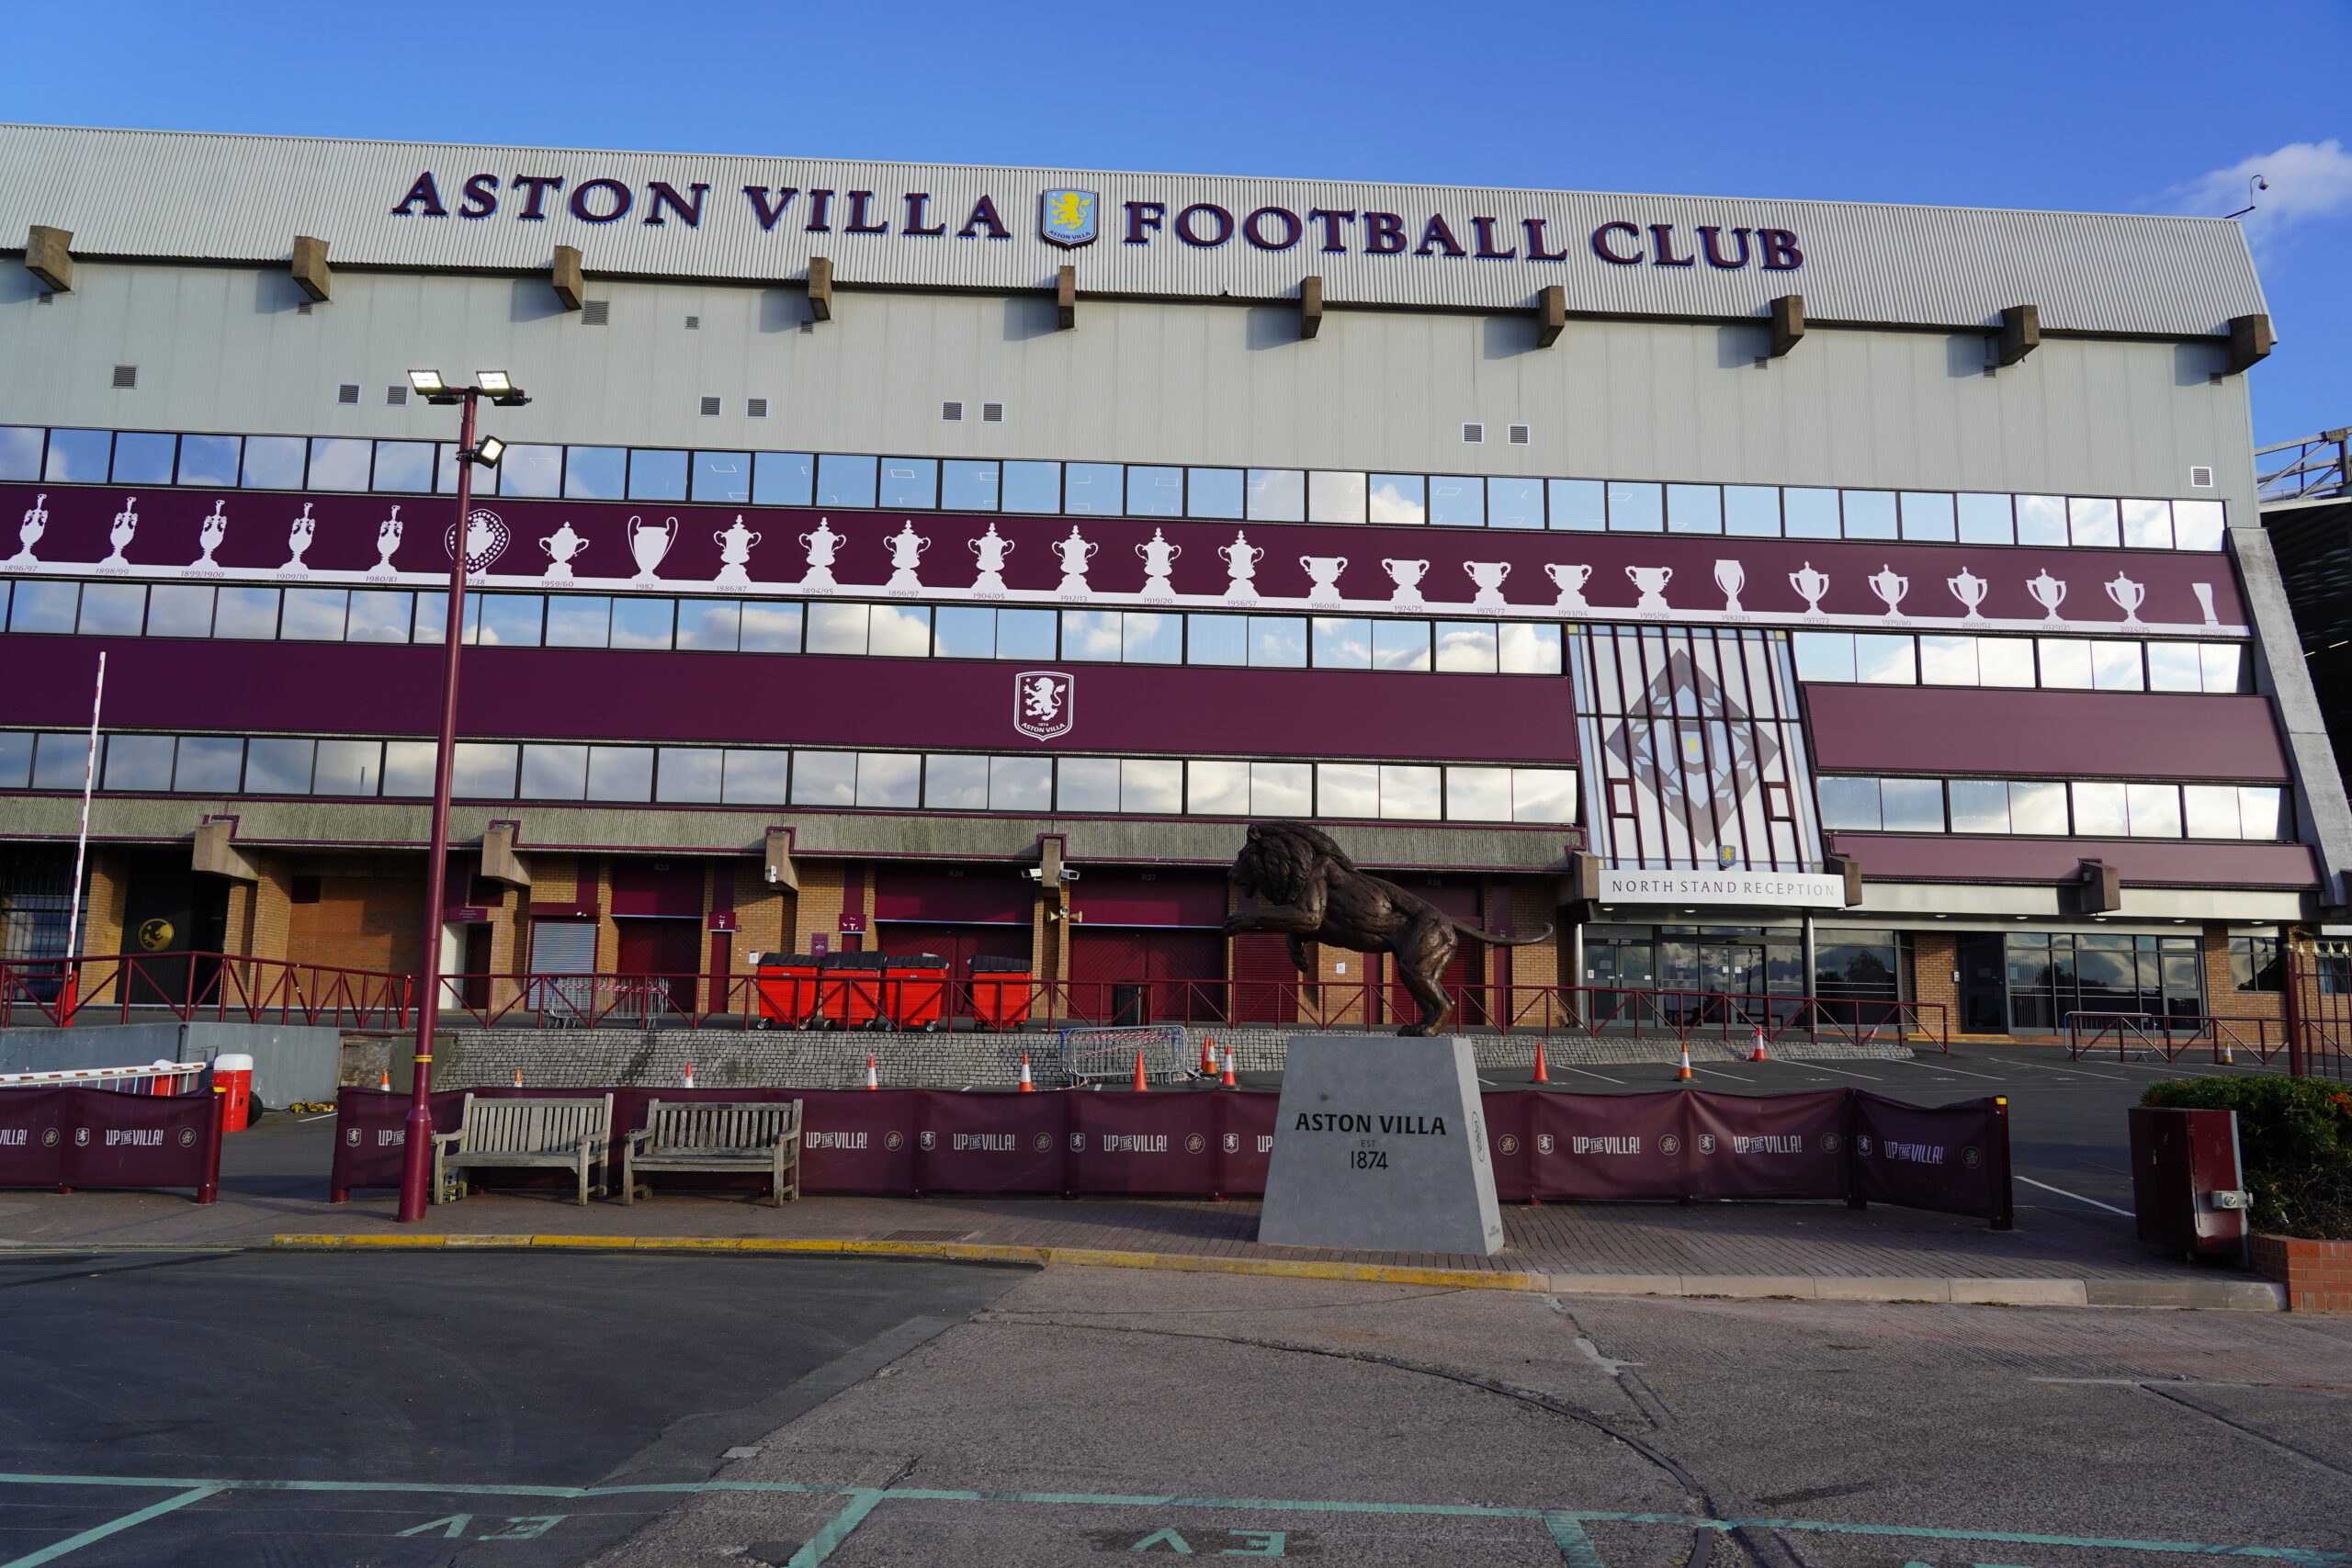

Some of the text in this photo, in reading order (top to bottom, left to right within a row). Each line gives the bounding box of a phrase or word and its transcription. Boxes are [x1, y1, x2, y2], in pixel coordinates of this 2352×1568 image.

[391, 170, 1804, 271] ASTON VILLA FOOTBALL CLUB
[1049, 230, 1070, 239] ASTON
[4, 565, 38, 573] 1896/97
[95, 568, 130, 576] 1898/99
[180, 570, 225, 579] 1899/1900
[276, 572, 309, 581] 1909/10
[366, 575, 398, 583] 1980/81
[541, 580, 574, 588] 1959/60
[716, 585, 748, 593] 1886/87
[888, 590, 920, 598] 1896/97
[973, 592, 1005, 601] 1904/05
[1060, 594, 1088, 603] 1912/13
[1143, 597, 1173, 605] 1919/20
[1311, 602, 1341, 610] 1960/61
[1394, 604, 1423, 613] 1974/75
[1476, 607, 1505, 615] 1976/77
[1639, 612, 1670, 620] 1995/96
[1022, 723, 1066, 732] ASTON VILLA
[1612, 879, 1835, 897] NORTH STAND RECEPTION
[1295, 1112, 1447, 1135] ASTON VILLA
[106, 1130, 120, 1145] UP
[120, 1132, 132, 1144] THE
[132, 1130, 164, 1145] VILLA!
[378, 1130, 393, 1145] UP
[805, 1132, 821, 1148] UP
[821, 1134, 834, 1147] THE
[834, 1132, 867, 1149] VILLA!
[953, 1134, 967, 1150] UP
[968, 1135, 981, 1148] THE
[981, 1134, 1015, 1150] VILLA!
[1103, 1134, 1118, 1152] UP
[1119, 1137, 1132, 1150] THE
[1133, 1135, 1168, 1152] VILLA!
[1257, 1135, 1273, 1153] UP
[1361, 1139, 1376, 1148] EST
[1573, 1136, 1589, 1154] UP
[1589, 1139, 1603, 1152] THE
[1603, 1136, 1640, 1154] VILLA!
[1734, 1136, 1750, 1154] UP
[1750, 1138, 1764, 1151] THE
[1764, 1135, 1803, 1154] VILLA!
[1884, 1141, 1897, 1159] UP
[1898, 1145, 1911, 1158] THE
[1910, 1144, 1944, 1165] VILLA!
[1351, 1150, 1388, 1170] 1874
